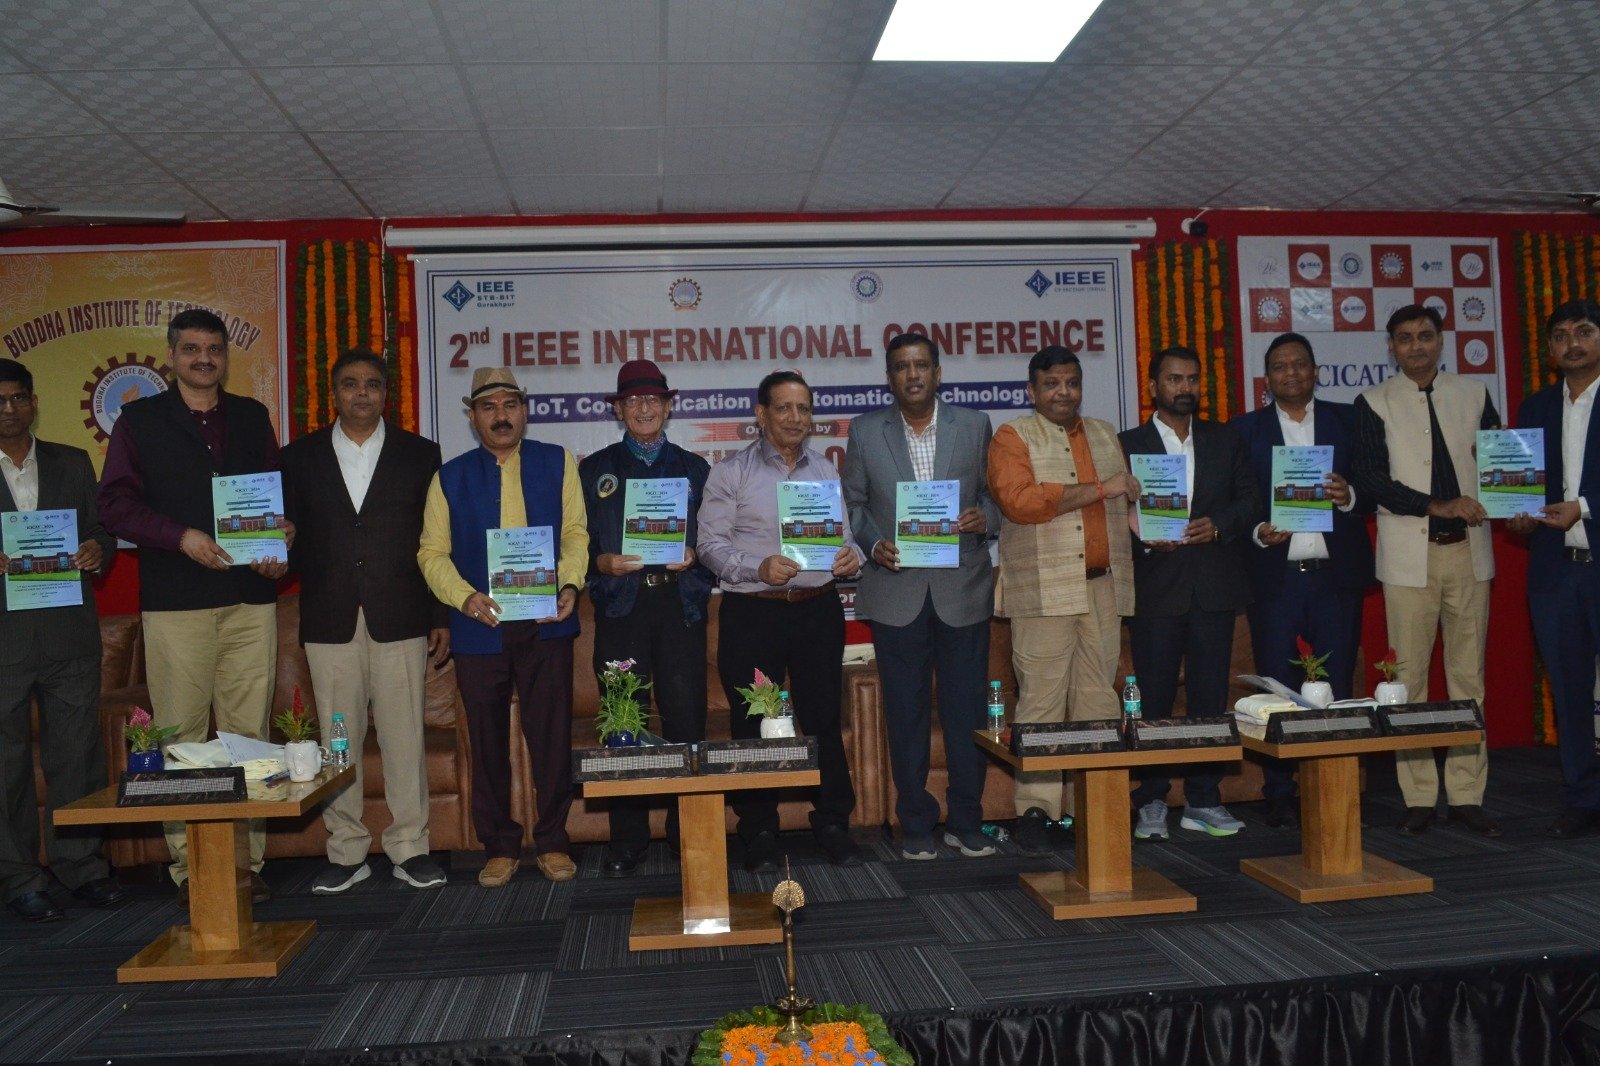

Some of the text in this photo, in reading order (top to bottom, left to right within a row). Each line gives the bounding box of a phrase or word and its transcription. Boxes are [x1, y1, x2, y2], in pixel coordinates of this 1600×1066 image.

[477, 281, 514, 292] IEEE
[1055, 271, 1105, 285] IEEE
[3, 299, 261, 359] BUDDHA INSTITUTE OF TEOGY
[449, 326, 490, 368] 2nd
[503, 330, 581, 367] IEEE
[592, 324, 872, 364] INTERNATIONAL
[104, 368, 137, 387] INSTITUTE
[147, 372, 165, 391] TECHN
[528, 386, 1031, 418] IoT, Coication tomatio chnolog
[815, 424, 832, 435] by
